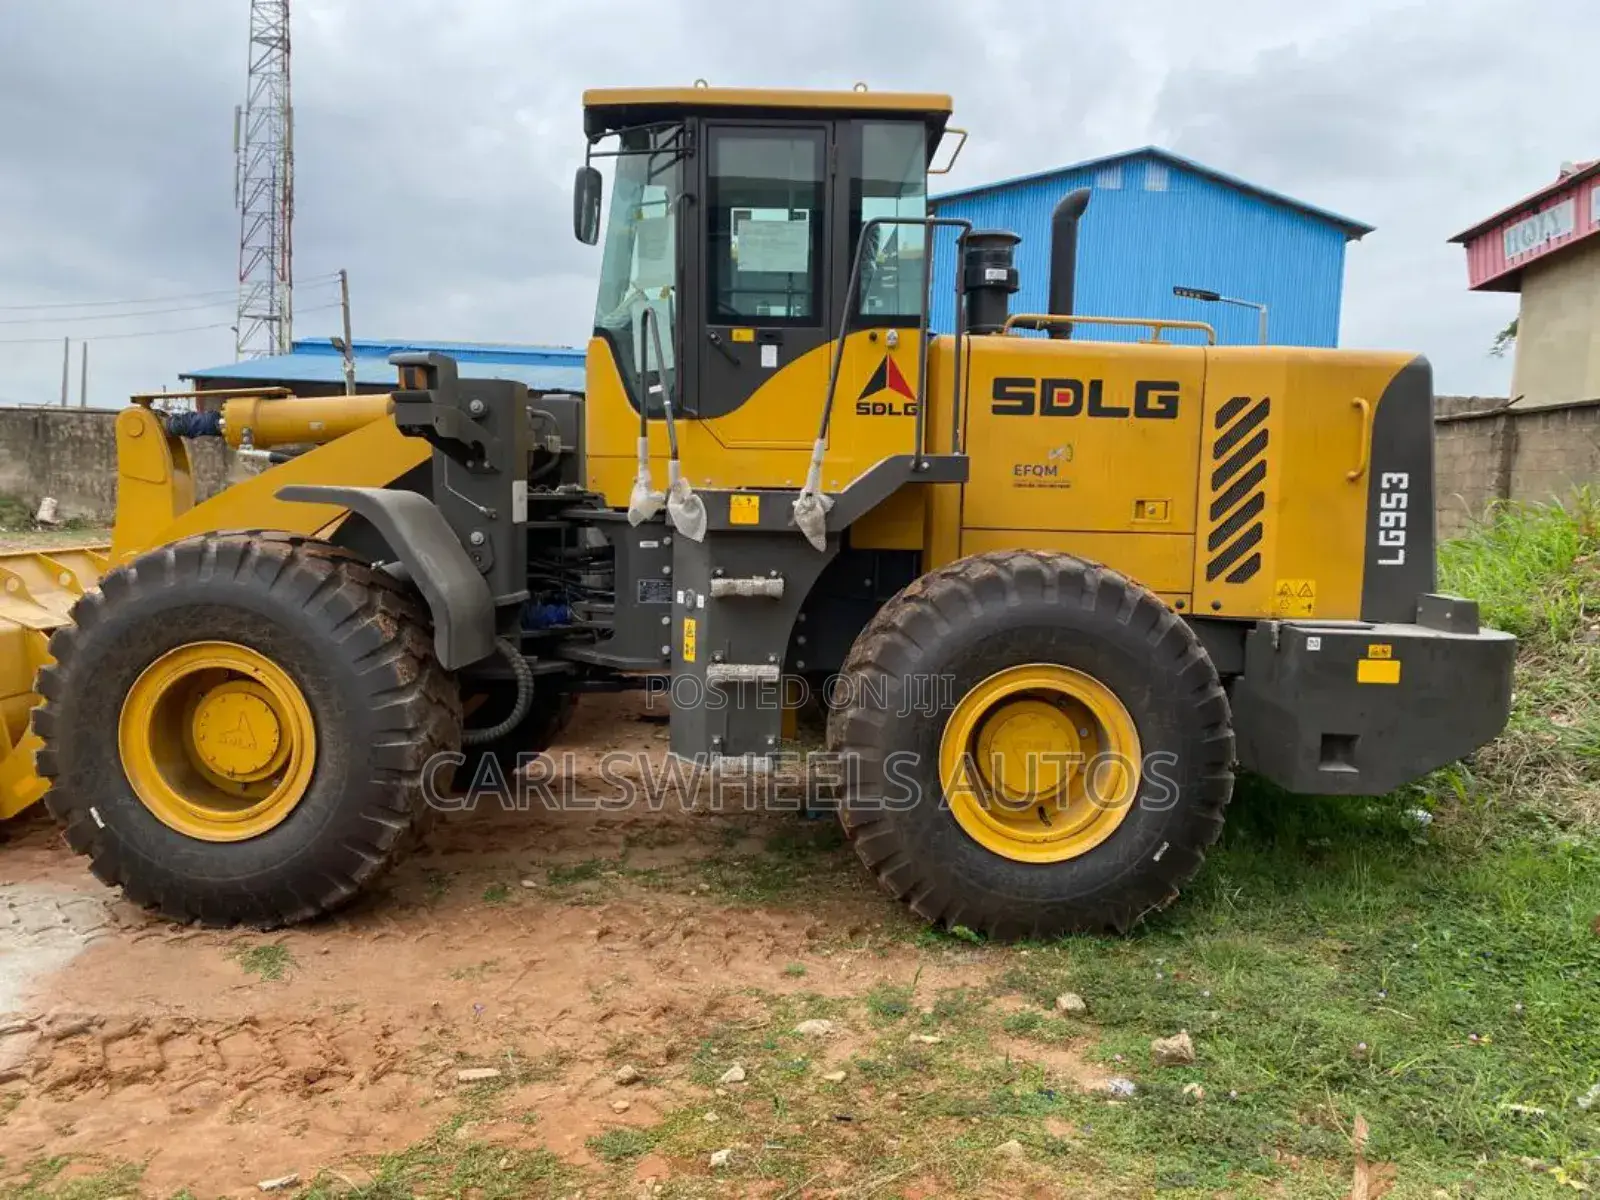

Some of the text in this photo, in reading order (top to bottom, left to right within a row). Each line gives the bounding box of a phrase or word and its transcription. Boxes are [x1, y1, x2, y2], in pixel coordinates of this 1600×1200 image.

[856, 402, 919, 416] SDLG
[991, 377, 1180, 419] SDLG
[1014, 464, 1058, 478] EFQM
[1378, 472, 1409, 565] LG953
